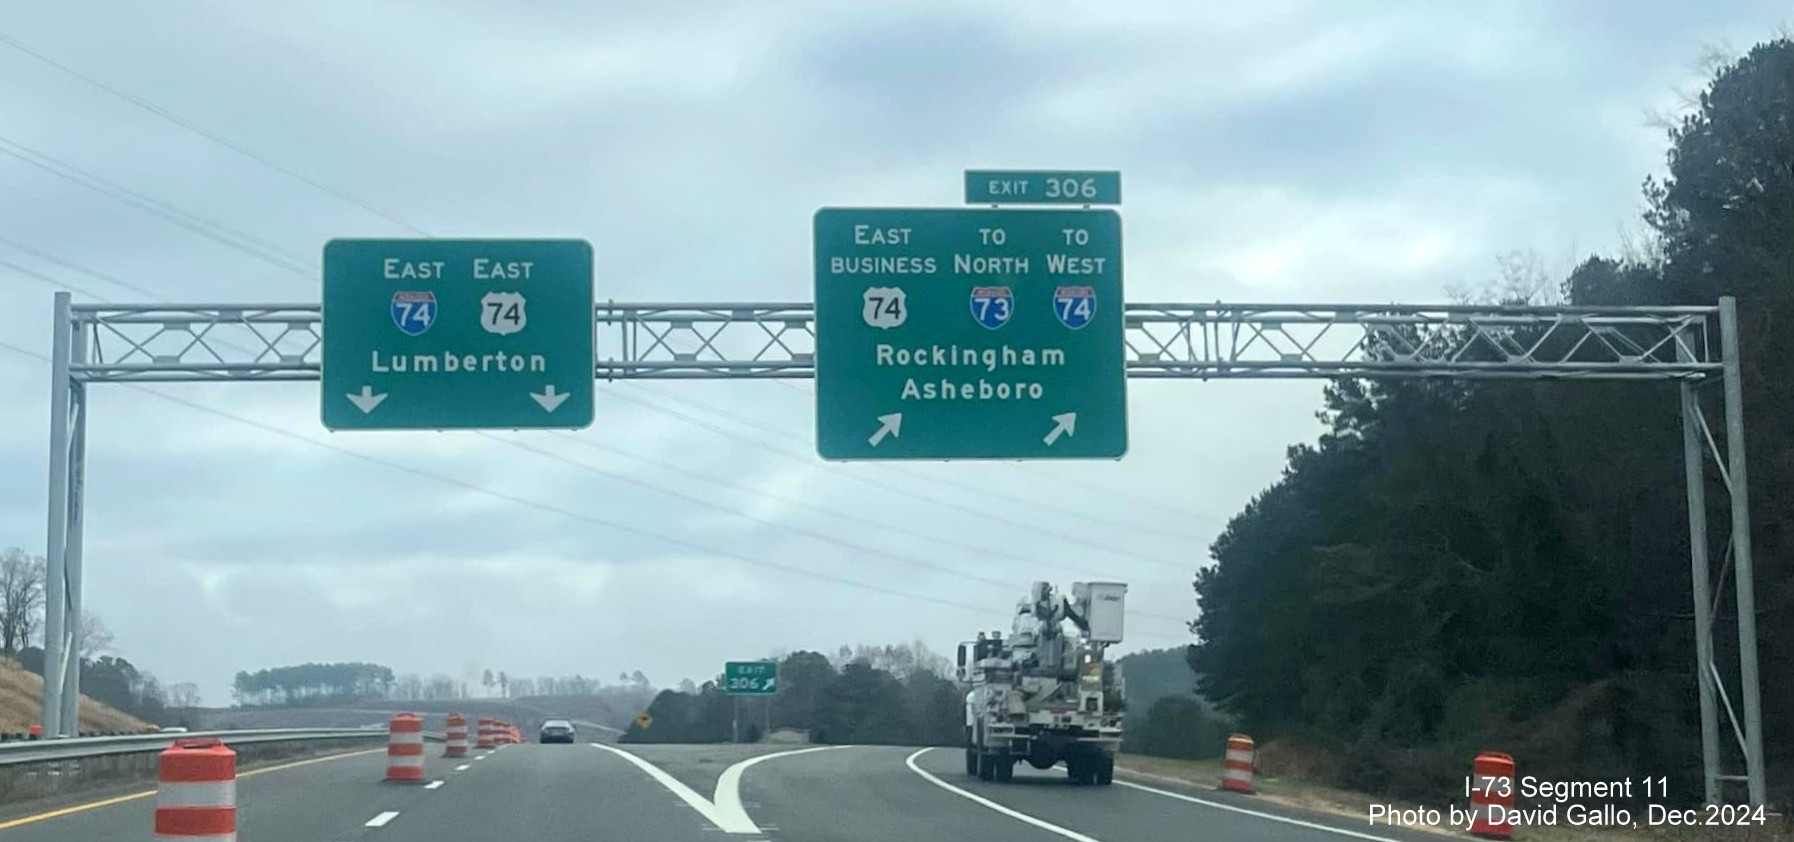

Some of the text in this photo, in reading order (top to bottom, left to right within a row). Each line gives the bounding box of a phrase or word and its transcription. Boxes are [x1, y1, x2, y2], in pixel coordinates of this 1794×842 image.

[989, 178, 1098, 198] EXIT 306
[854, 225, 912, 245] EAST
[979, 228, 1006, 245] TO
[1062, 228, 1089, 245] TO
[384, 258, 445, 279] EAST
[473, 258, 534, 279] EAST
[831, 257, 937, 274] BUSINESS
[954, 254, 1029, 274] NORTH
[1046, 254, 1106, 274] WEST
[395, 302, 431, 327] 74
[487, 302, 521, 325] 74
[868, 297, 901, 320] 74
[973, 298, 1010, 321] 73
[1057, 298, 1092, 321] 74
[372, 350, 546, 372] Lumberton
[876, 344, 1065, 372] Rockingham
[901, 378, 1044, 400] Asheboro
[730, 677, 759, 689] 306
